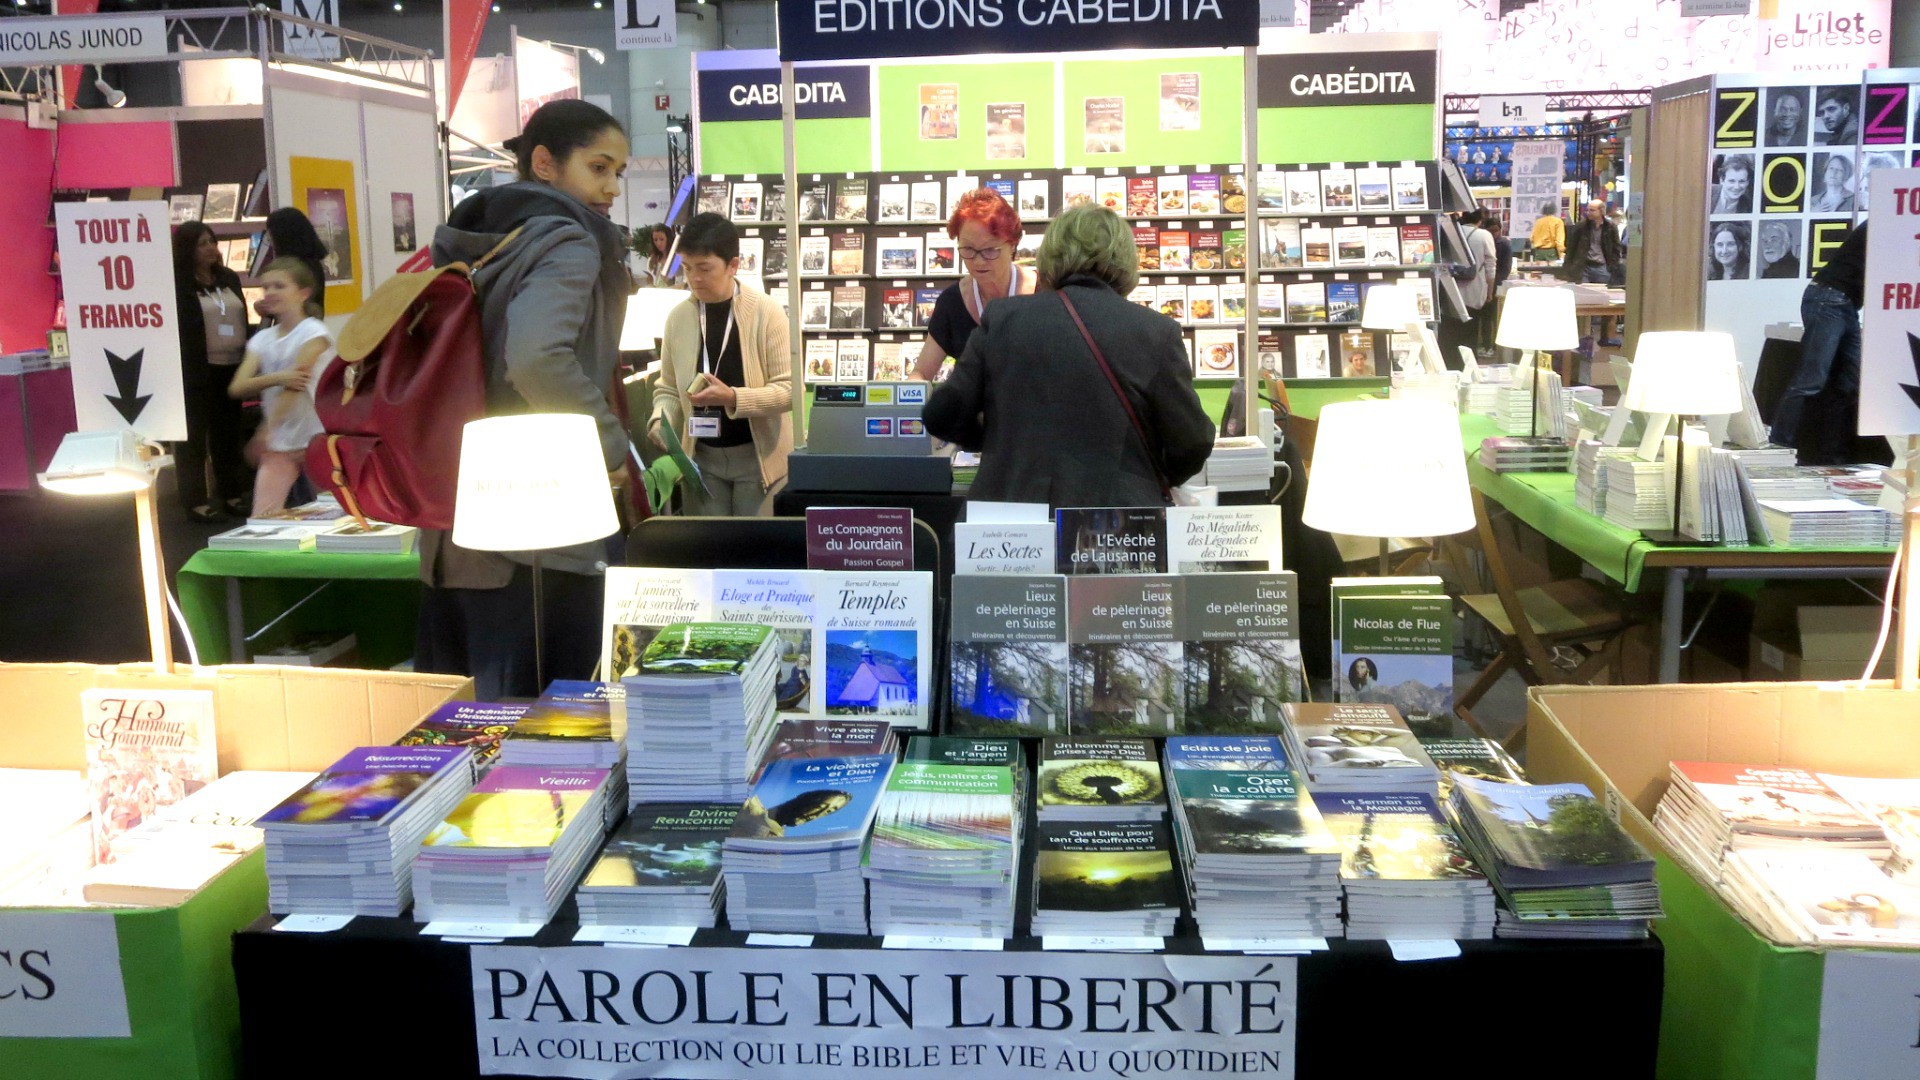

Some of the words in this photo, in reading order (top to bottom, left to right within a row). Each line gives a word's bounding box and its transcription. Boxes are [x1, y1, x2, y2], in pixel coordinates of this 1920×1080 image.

[1795, 11, 1864, 33] L'îlot
[78, 27, 142, 49] JUNOD
[621, 35, 661, 45] continue
[662, 33, 673, 44] là
[1764, 28, 1882, 55] jeunesse
[1290, 66, 1416, 96] CABÉDITA
[729, 81, 846, 106] CABDITA
[75, 219, 130, 244] TOUT
[136, 212, 151, 243] À
[98, 255, 135, 291] 10
[79, 302, 164, 330] FRANCS
[903, 389, 922, 397] VISA
[818, 525, 834, 534] Les
[835, 524, 903, 536] Compagnons
[1186, 521, 1205, 534] Des
[1207, 520, 1263, 535] Mégalithes,
[826, 538, 842, 550] du
[847, 538, 903, 550] Jourdain
[1097, 533, 1157, 546] L'Evêché
[1187, 535, 1204, 546] des
[1204, 534, 1249, 548] Légendes
[1249, 535, 1259, 545] et
[968, 541, 996, 560] Les
[998, 541, 1043, 560] Sectes
[1071, 550, 1089, 562] de
[1092, 549, 1157, 562] Lausanne
[1201, 547, 1217, 559] des
[1219, 546, 1250, 558] Dieux
[844, 559, 873, 567] Passion
[876, 559, 904, 568] Gospel
[634, 582, 682, 597] Lumières
[1256, 588, 1288, 600] Lieux
[720, 588, 752, 604] Eloge
[753, 591, 765, 603] et
[766, 588, 815, 606] Pratique
[838, 588, 908, 615] Temples
[1025, 590, 1056, 602] Lieux
[1142, 590, 1172, 602] Lieux
[616, 601, 632, 609] sur
[636, 596, 647, 608] la
[649, 599, 700, 612] sorcellerie
[761, 603, 772, 612] des
[1206, 602, 1221, 614] de
[1224, 601, 1288, 615] pèlerinage
[719, 609, 754, 622] Saints
[757, 610, 815, 624] guérisseurs
[976, 604, 991, 615] de
[994, 604, 1056, 617] pèlerinage
[1092, 604, 1107, 616] de
[1111, 604, 1173, 618] pèlerinage
[619, 613, 628, 623] et
[631, 611, 642, 623] le
[643, 613, 695, 624] satanisme
[827, 616, 839, 628] de
[841, 616, 872, 628] Suisse
[873, 616, 917, 628] romande
[1005, 619, 1018, 629] en
[1022, 618, 1056, 629] Suisse
[1122, 619, 1136, 629] en
[1140, 618, 1173, 629] Suisse
[1236, 617, 1252, 627] en
[1254, 616, 1288, 627] Suisse
[1353, 618, 1394, 629] Nicolas
[1397, 618, 1414, 630] de
[1417, 618, 1441, 630] Flue
[1015, 632, 1057, 640] découvertes
[1132, 632, 1173, 640] découvertes
[1203, 630, 1236, 638] Itinéraires
[1238, 630, 1245, 638] et
[1247, 630, 1289, 638] découvertes
[99, 698, 185, 731] Humour
[87, 717, 186, 750] Gourmand
[846, 732, 875, 740] mort
[974, 744, 1008, 752] Dieu
[1181, 744, 1220, 752] Eclats
[1245, 745, 1272, 754] joie
[826, 762, 880, 771] violence
[846, 769, 876, 777] Dieu
[938, 772, 979, 780] maître
[539, 777, 591, 786] Vieillir
[898, 778, 998, 787] communication
[1246, 775, 1291, 786] Oser
[1213, 784, 1231, 793] la
[1237, 784, 1296, 793] colère
[655, 817, 734, 825] Rencontre
[1091, 836, 1155, 844] souffrance?
[1127, 830, 1154, 838] pour
[484, 967, 789, 1027] PAROLE
[812, 972, 920, 1030] EN
[945, 961, 1284, 1036] LIBERTÉ
[492, 1036, 531, 1060] LA
[536, 1037, 725, 1064] COLLECTION
[732, 1040, 787, 1069] QUI
[795, 1042, 843, 1067] LIE
[852, 1043, 939, 1069] BIBLE
[950, 1043, 988, 1069] ET
[996, 1044, 1047, 1070] VIE
[1057, 1048, 1098, 1073] AU
[1107, 1049, 1281, 1078] QUOTIDIEN
